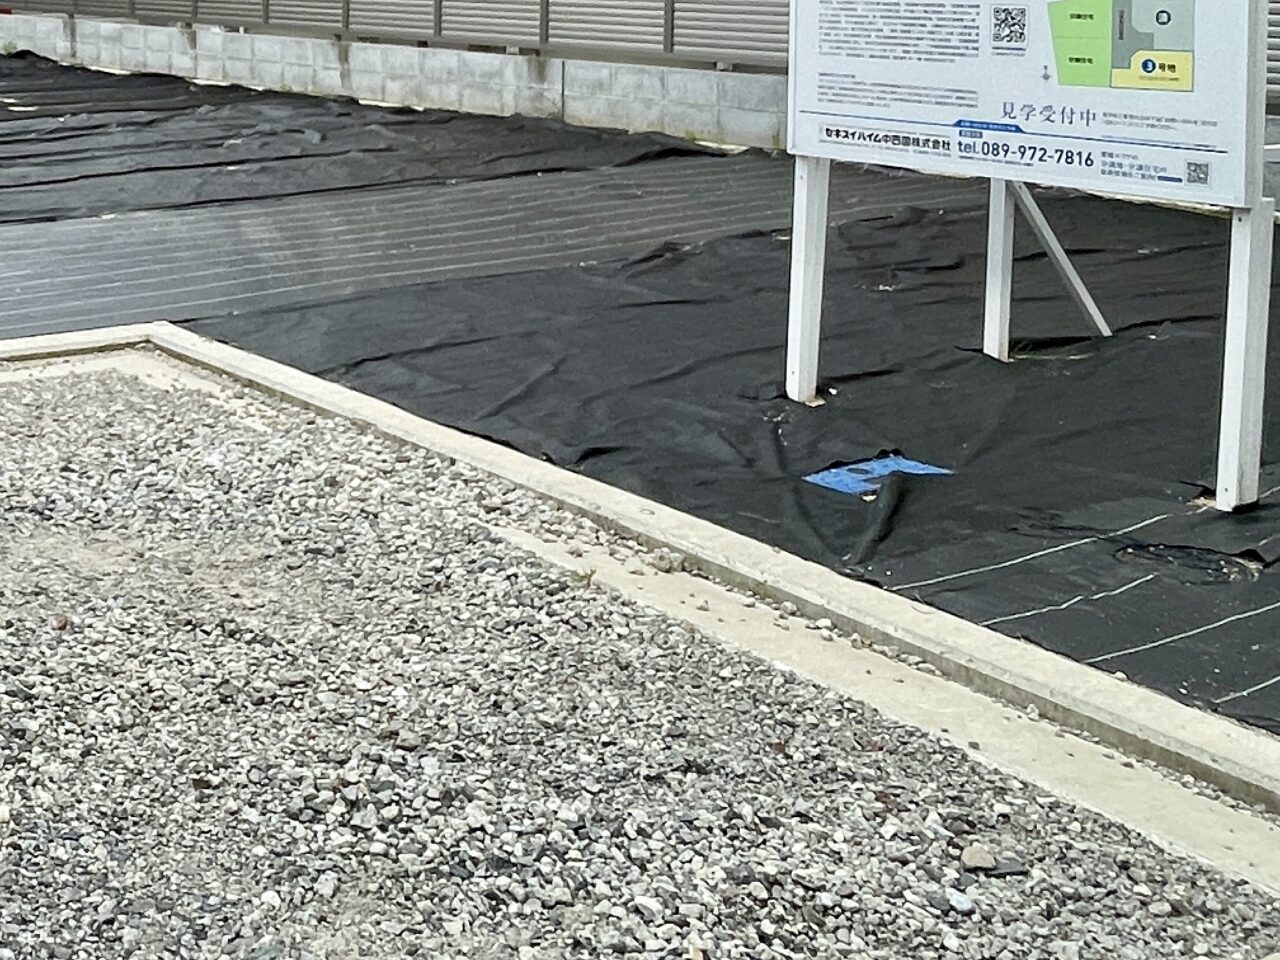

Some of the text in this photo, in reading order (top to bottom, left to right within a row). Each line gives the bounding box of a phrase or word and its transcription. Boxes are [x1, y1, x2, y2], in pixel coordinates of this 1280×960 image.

[1001, 101, 1096, 127] 見学受付中
[825, 127, 951, 152] セキスイハイム中四国株式会社
